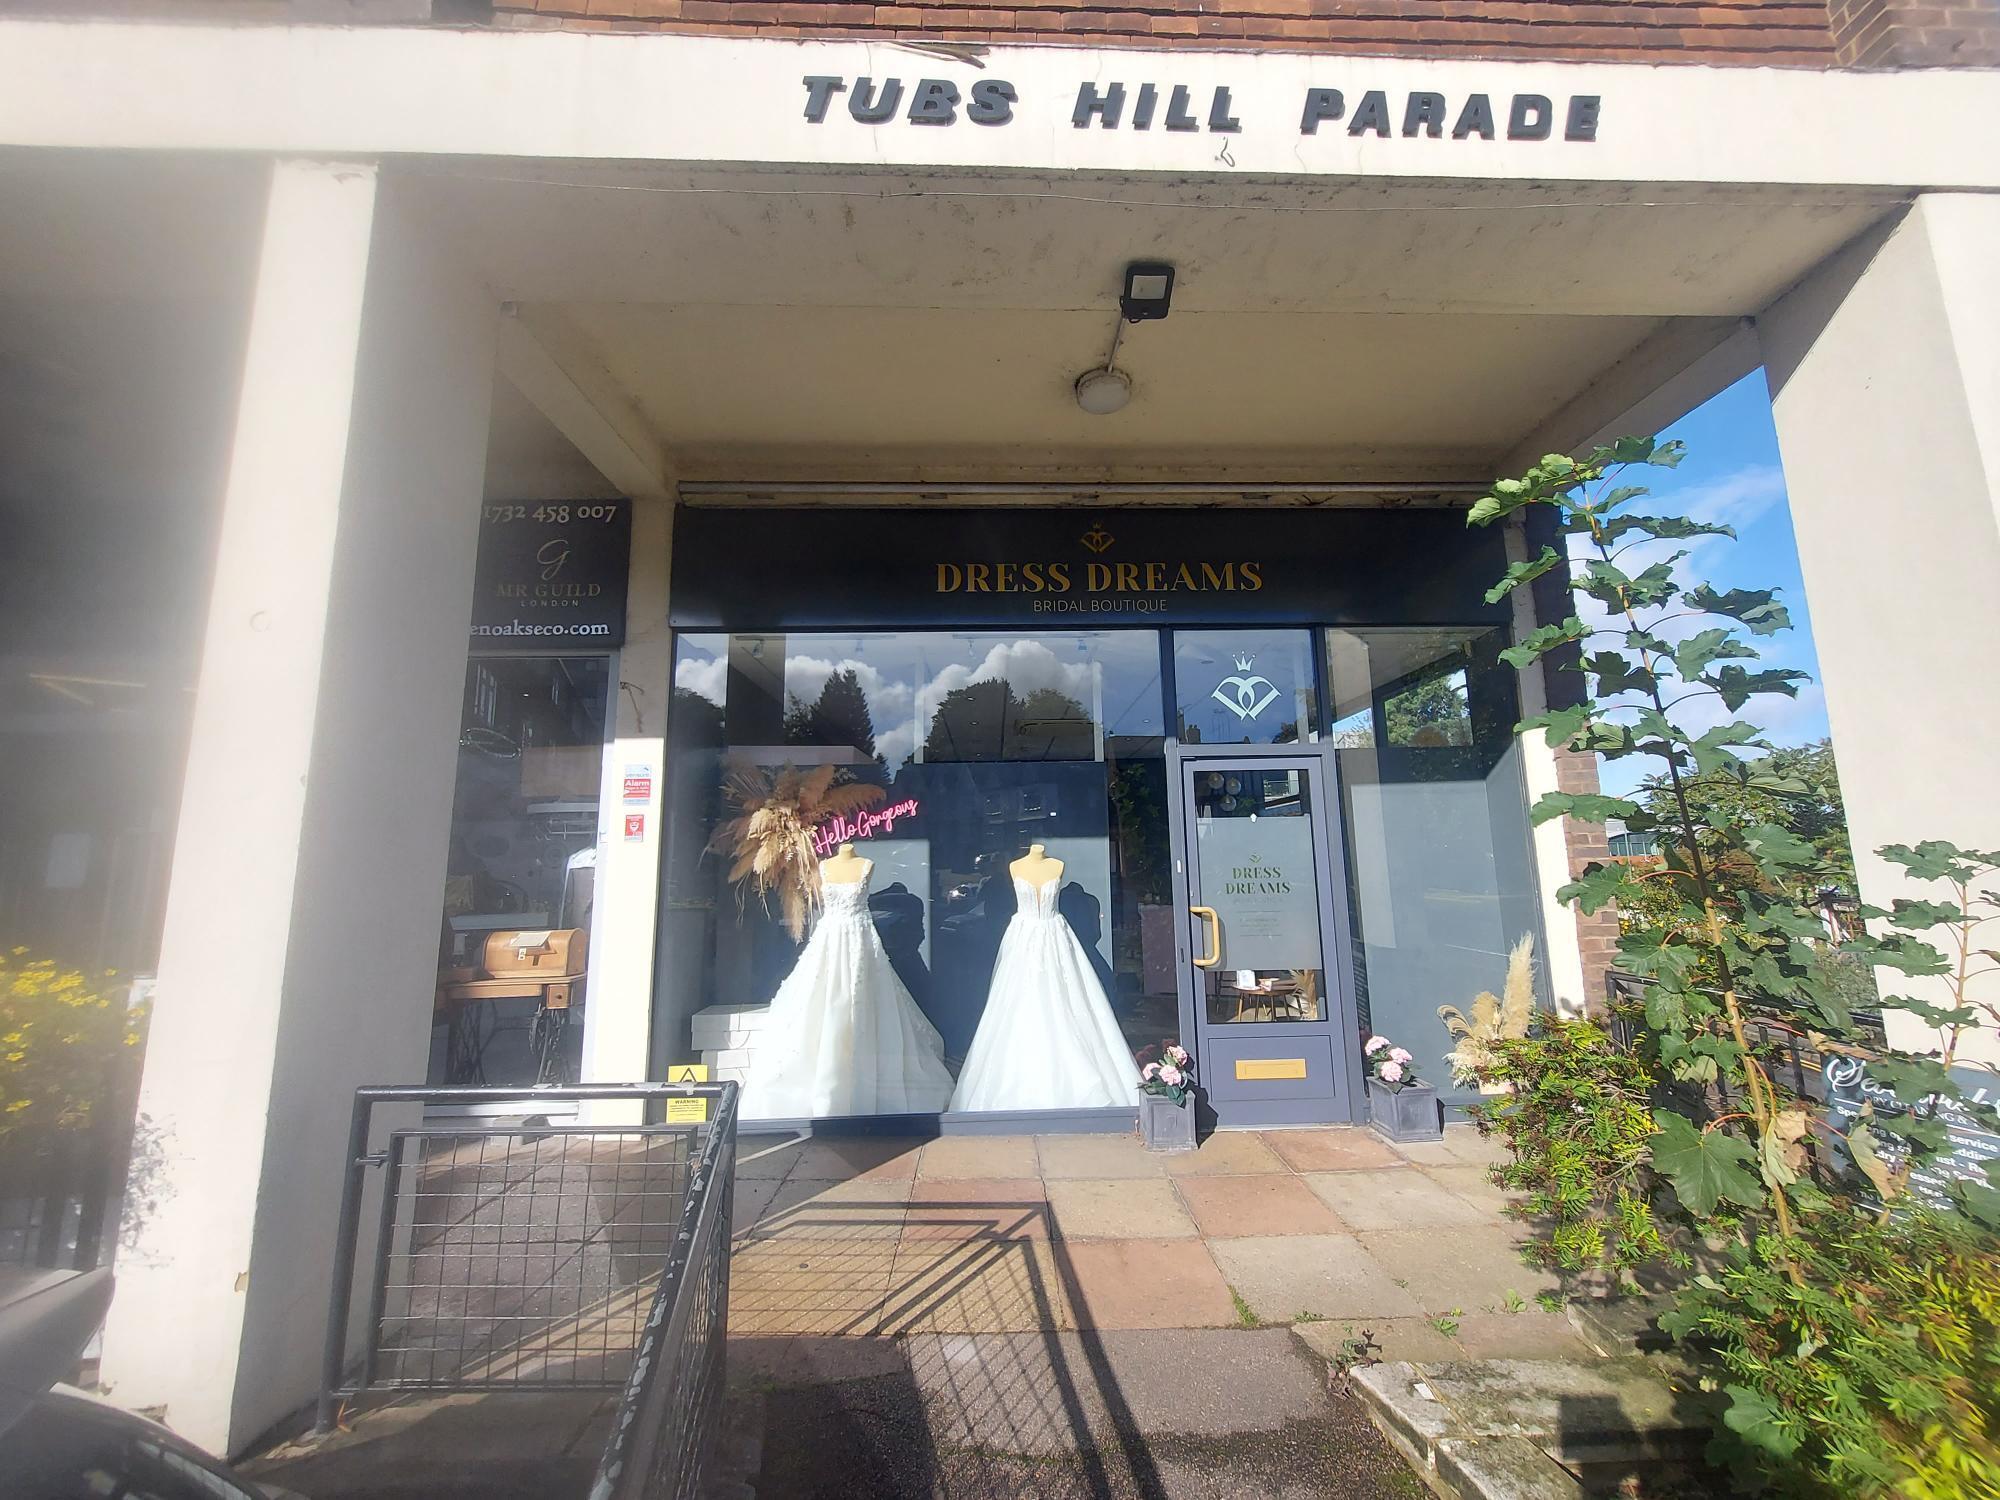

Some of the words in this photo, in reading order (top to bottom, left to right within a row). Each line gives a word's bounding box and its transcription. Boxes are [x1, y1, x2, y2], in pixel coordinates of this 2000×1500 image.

[803, 75, 1018, 126] TUBS
[1073, 81, 1243, 132] HILL
[1301, 86, 1601, 143] PARADE
[532, 505, 571, 524] 458
[577, 505, 617, 523] 007
[935, 562, 1071, 593] DRESS
[1086, 561, 1264, 593] DREAMS
[535, 583, 601, 597] GUILD
[520, 599, 579, 607] LONDON
[1033, 599, 1088, 613] BRIDAL
[1091, 599, 1168, 614] BOUTIQUE
[812, 816, 857, 856] Hello
[857, 799, 918, 838] Gorgeous
[1232, 866, 1282, 880] DRESS
[1225, 881, 1292, 895] DREAMS
